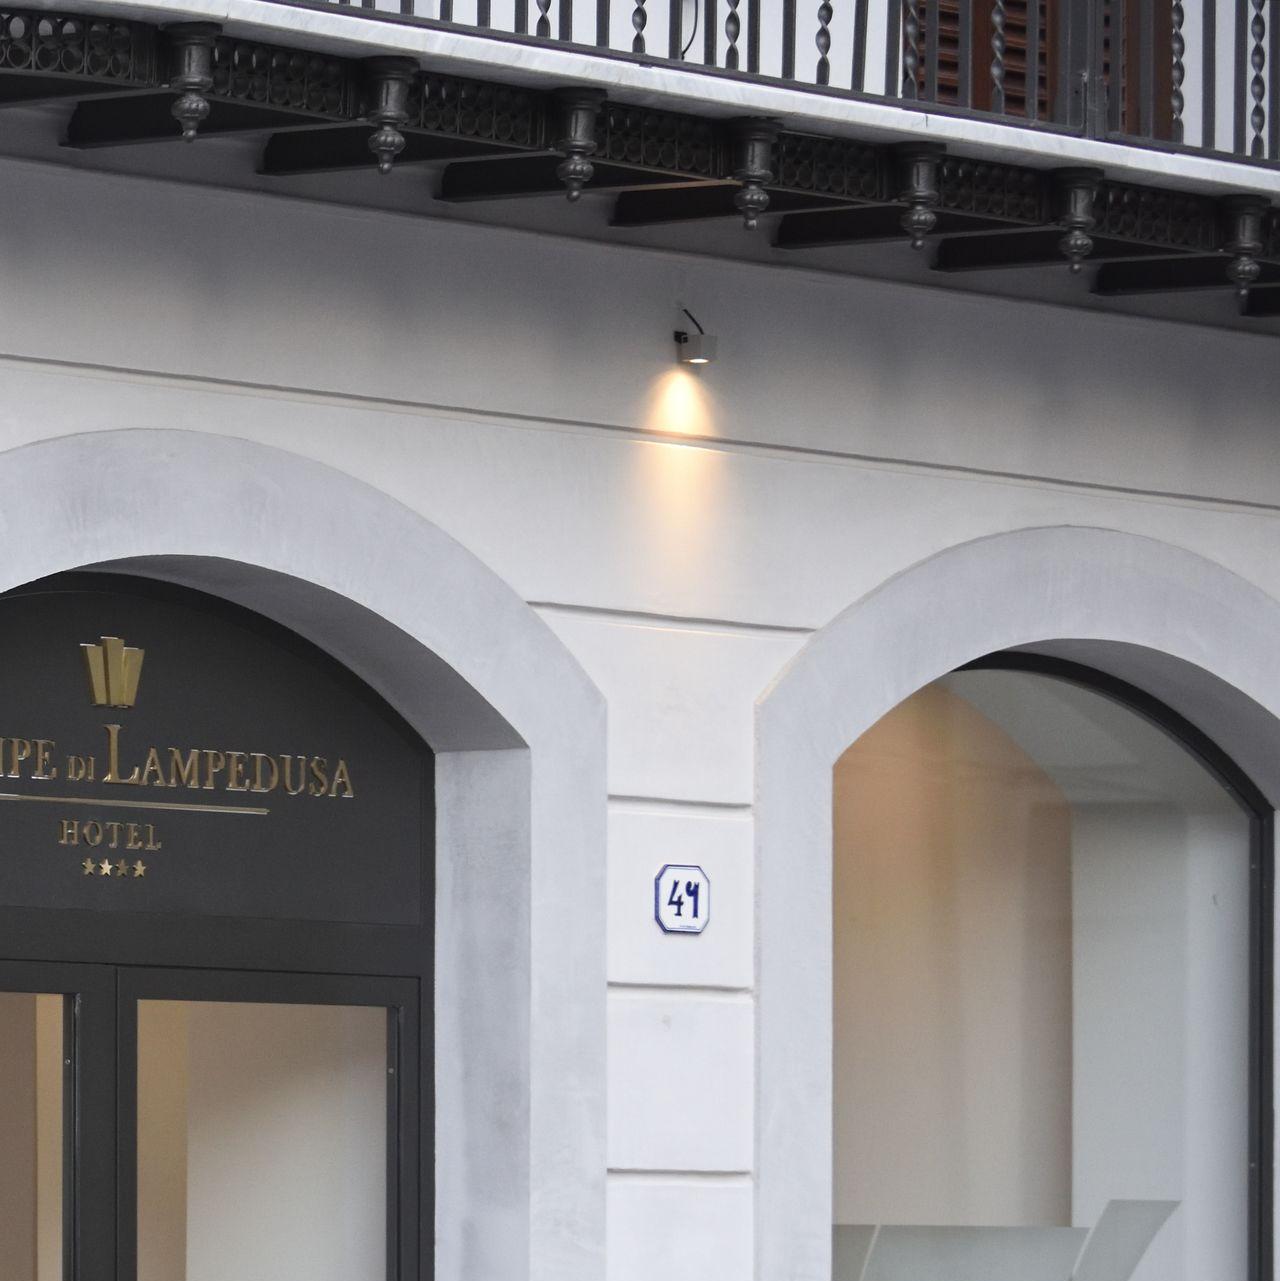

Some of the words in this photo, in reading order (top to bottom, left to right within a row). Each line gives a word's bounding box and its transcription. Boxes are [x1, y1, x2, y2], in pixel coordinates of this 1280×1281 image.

[67, 754, 95, 782] DI
[101, 723, 354, 798] LAMPEDUSA
[58, 819, 162, 851] HOTEL
